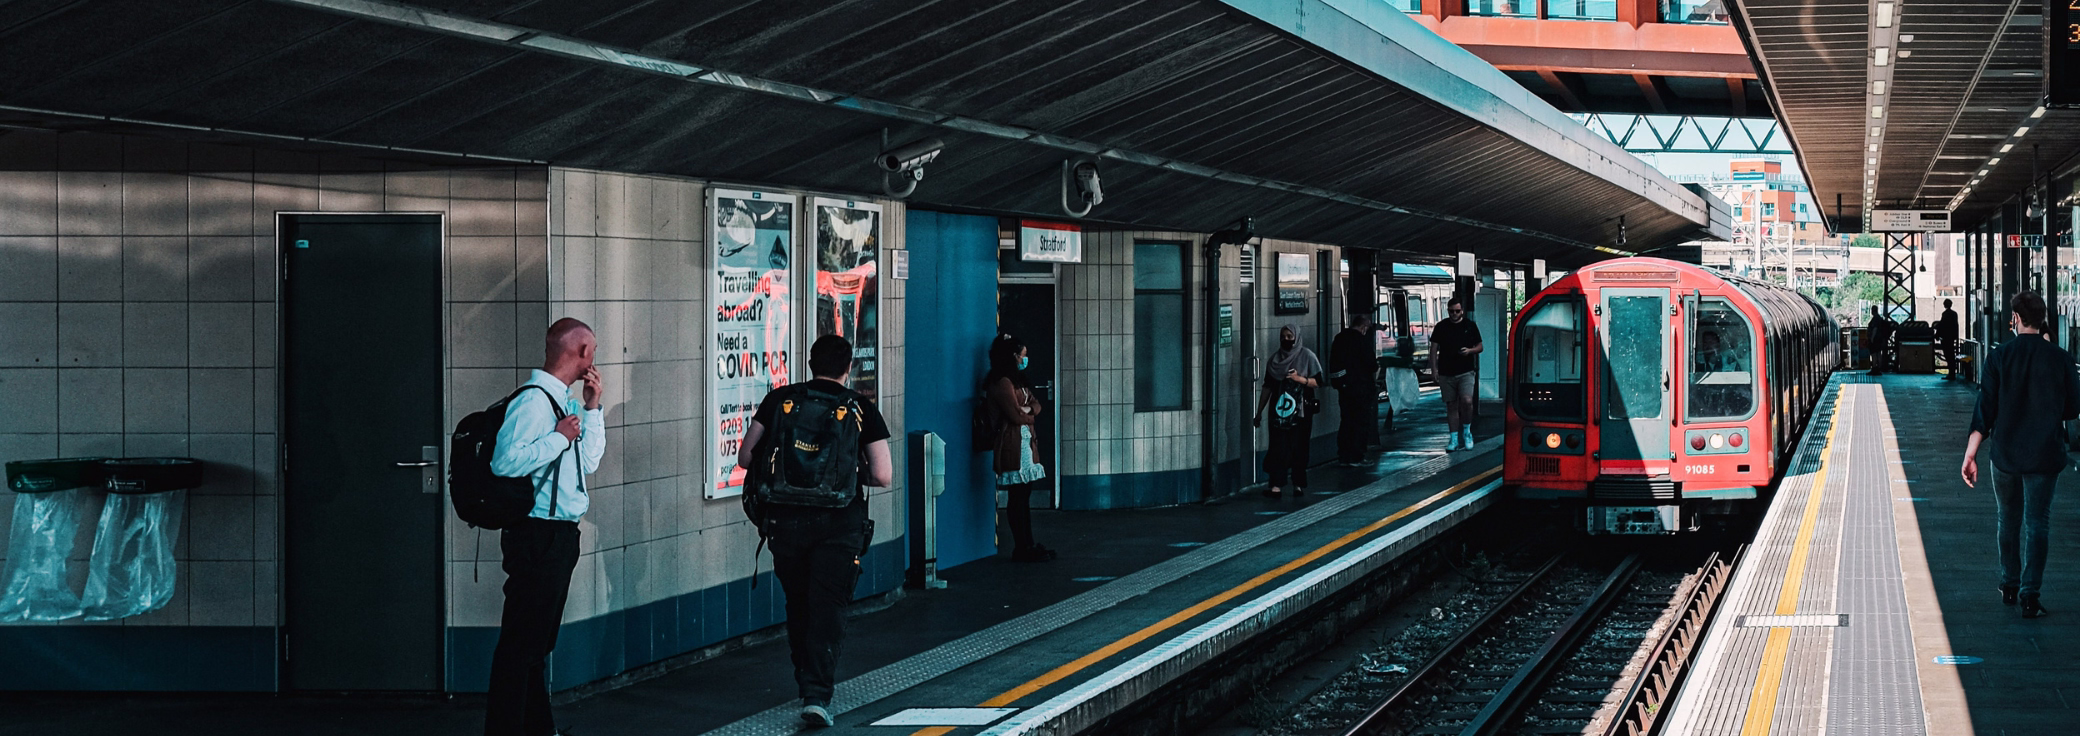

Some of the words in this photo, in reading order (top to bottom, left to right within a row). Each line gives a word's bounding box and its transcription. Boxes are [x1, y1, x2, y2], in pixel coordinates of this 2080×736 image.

[2069, 23, 2080, 42] 3
[1040, 234, 1066, 252] Stratford
[717, 270, 770, 298] Travelling
[717, 299, 763, 322] abroad?
[717, 332, 740, 351] Need
[742, 336, 748, 349] a
[717, 352, 759, 379] COVID
[761, 350, 788, 376] PCR
[720, 417, 743, 436] 0203
[1685, 464, 1715, 475] 91085
